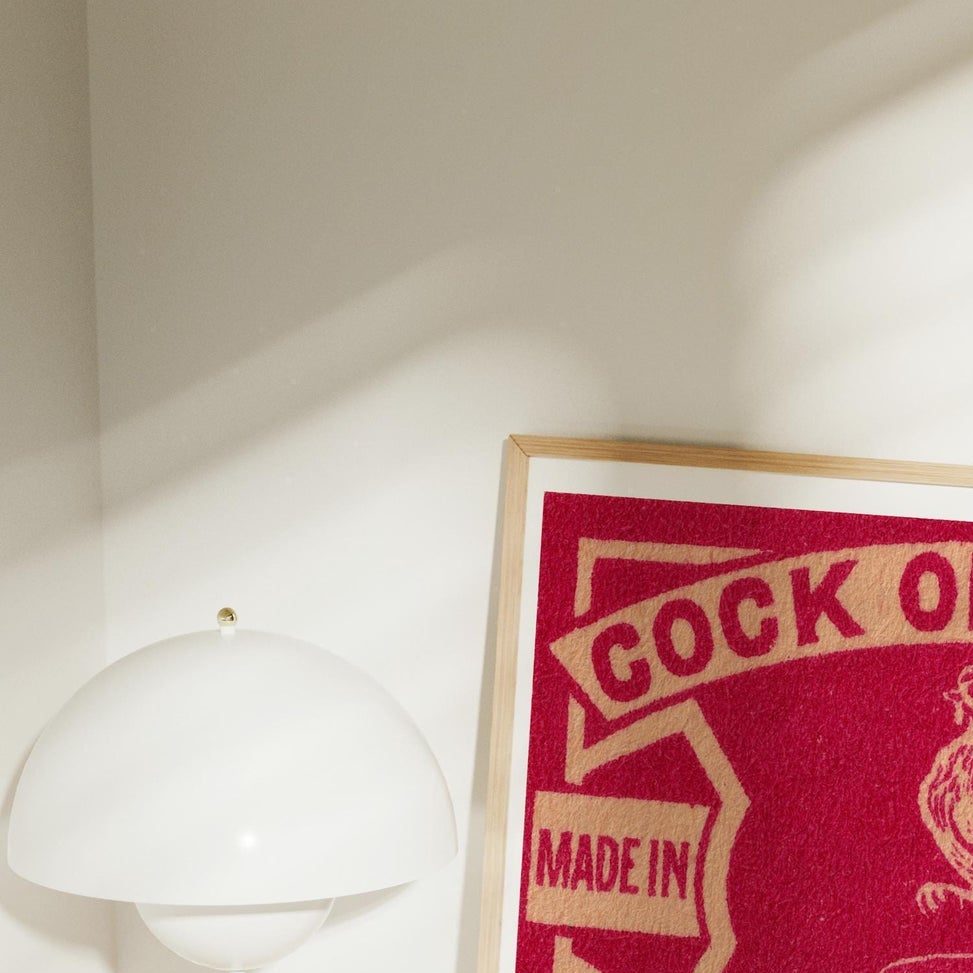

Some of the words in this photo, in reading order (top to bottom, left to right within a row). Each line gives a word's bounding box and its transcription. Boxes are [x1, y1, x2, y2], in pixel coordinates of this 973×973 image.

[591, 559, 866, 702] COCK
[535, 828, 640, 896] MADE
[648, 839, 690, 900] IN
